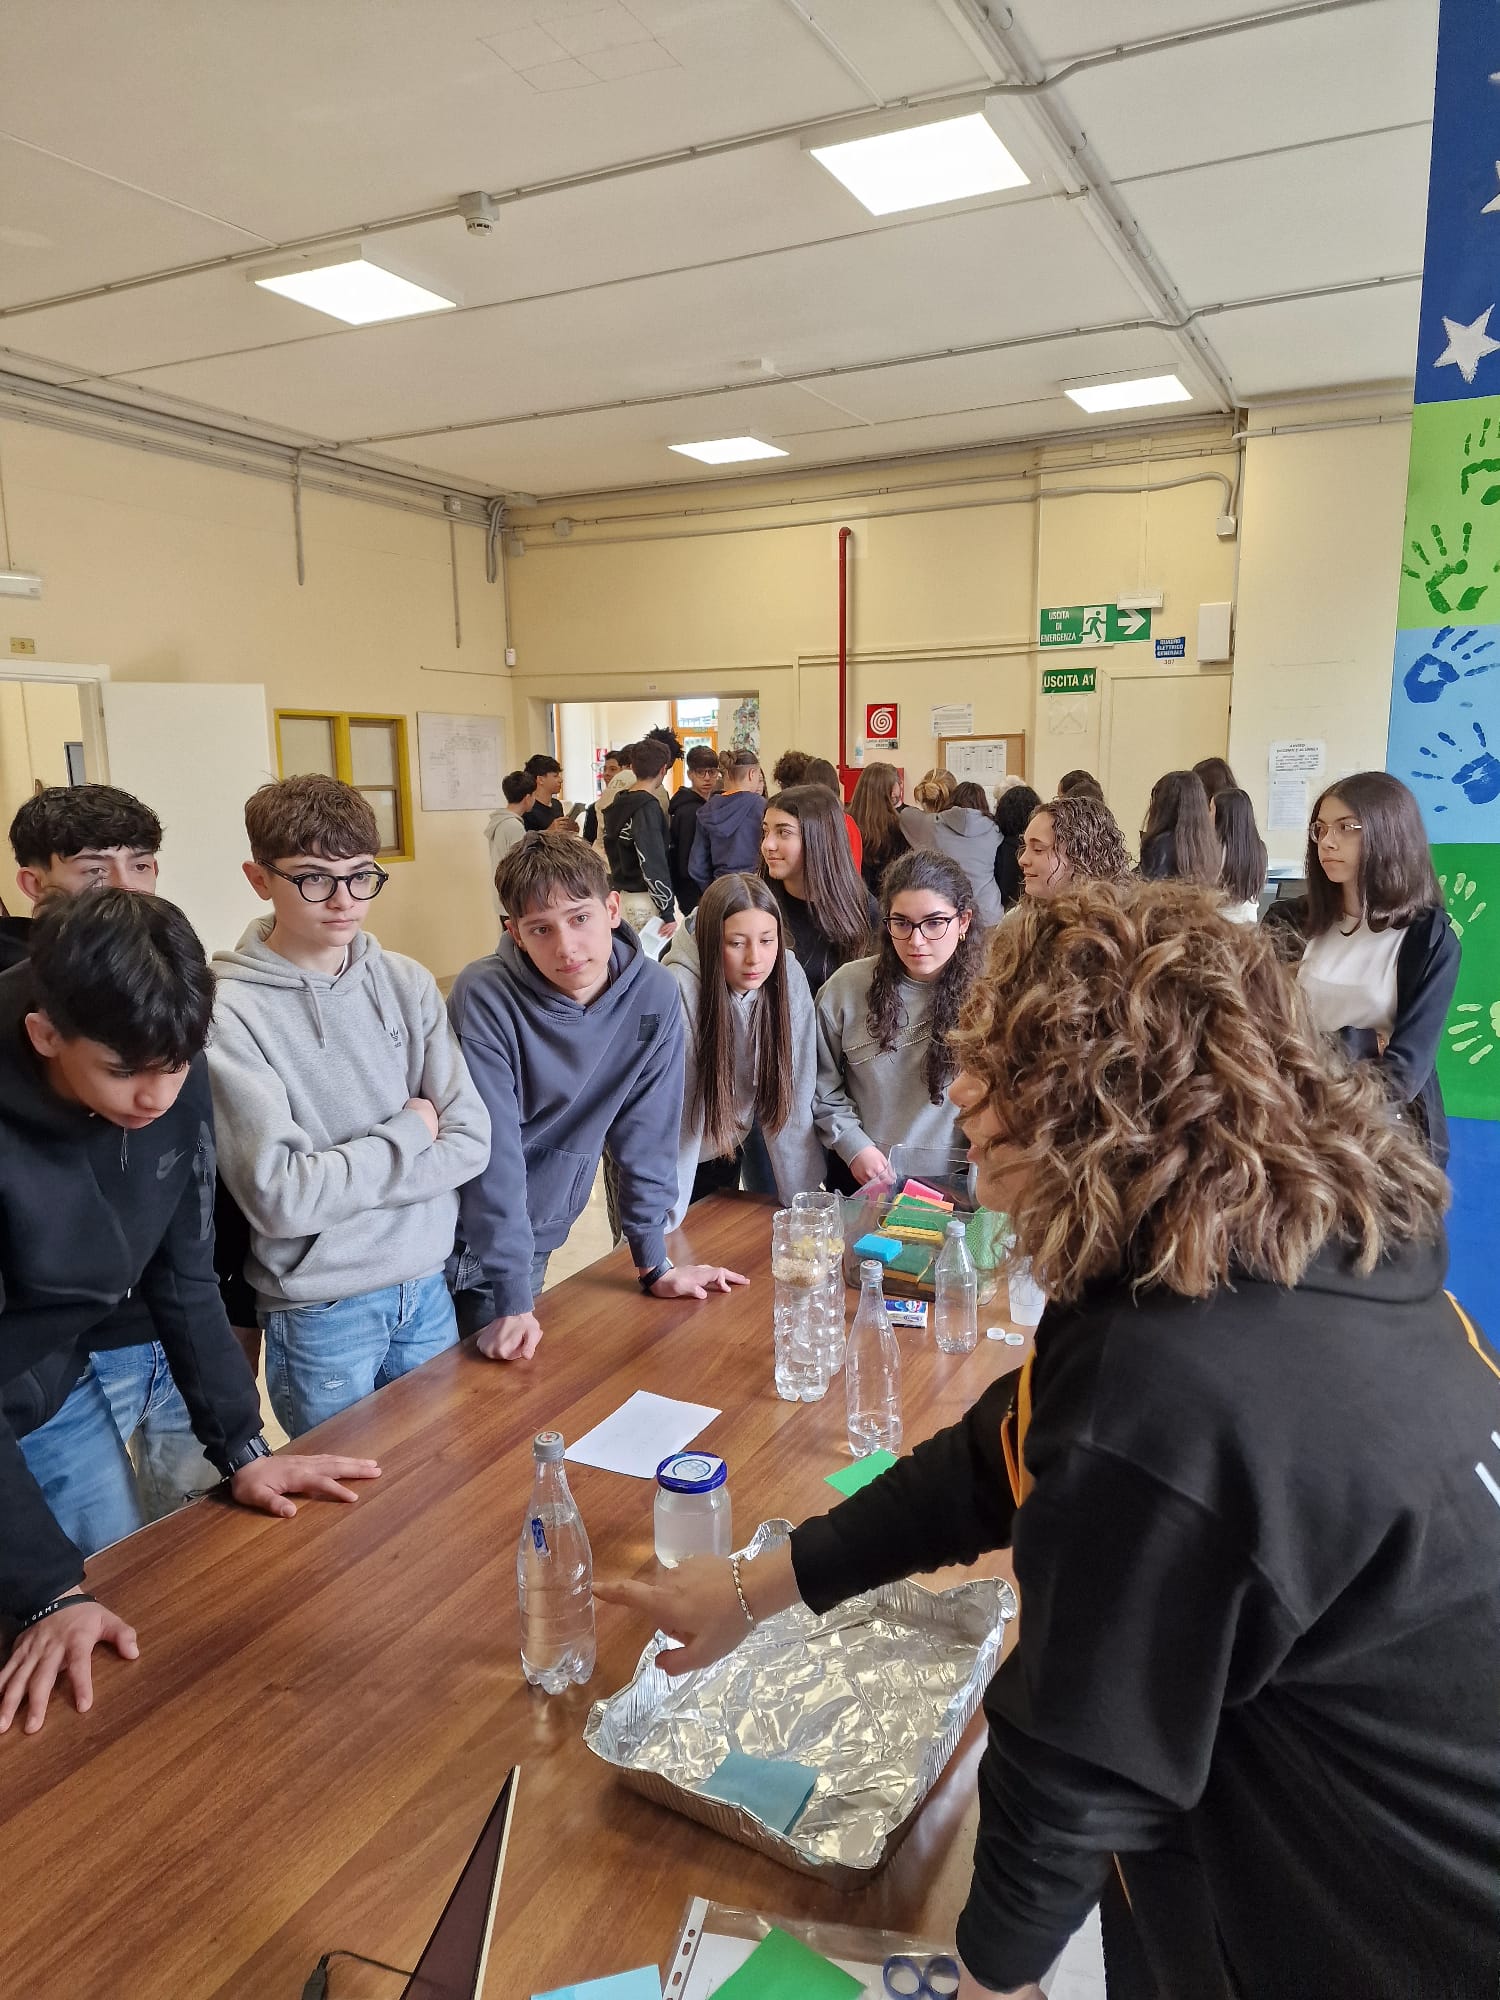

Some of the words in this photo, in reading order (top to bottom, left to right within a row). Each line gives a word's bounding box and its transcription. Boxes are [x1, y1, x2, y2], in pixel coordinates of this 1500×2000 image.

[1048, 610, 1070, 620] USCITA
[1055, 622, 1062, 631] DI
[1041, 632, 1076, 642] EMERGENZA
[1043, 674, 1080, 688] USCITA
[1081, 673, 1095, 686] A1
